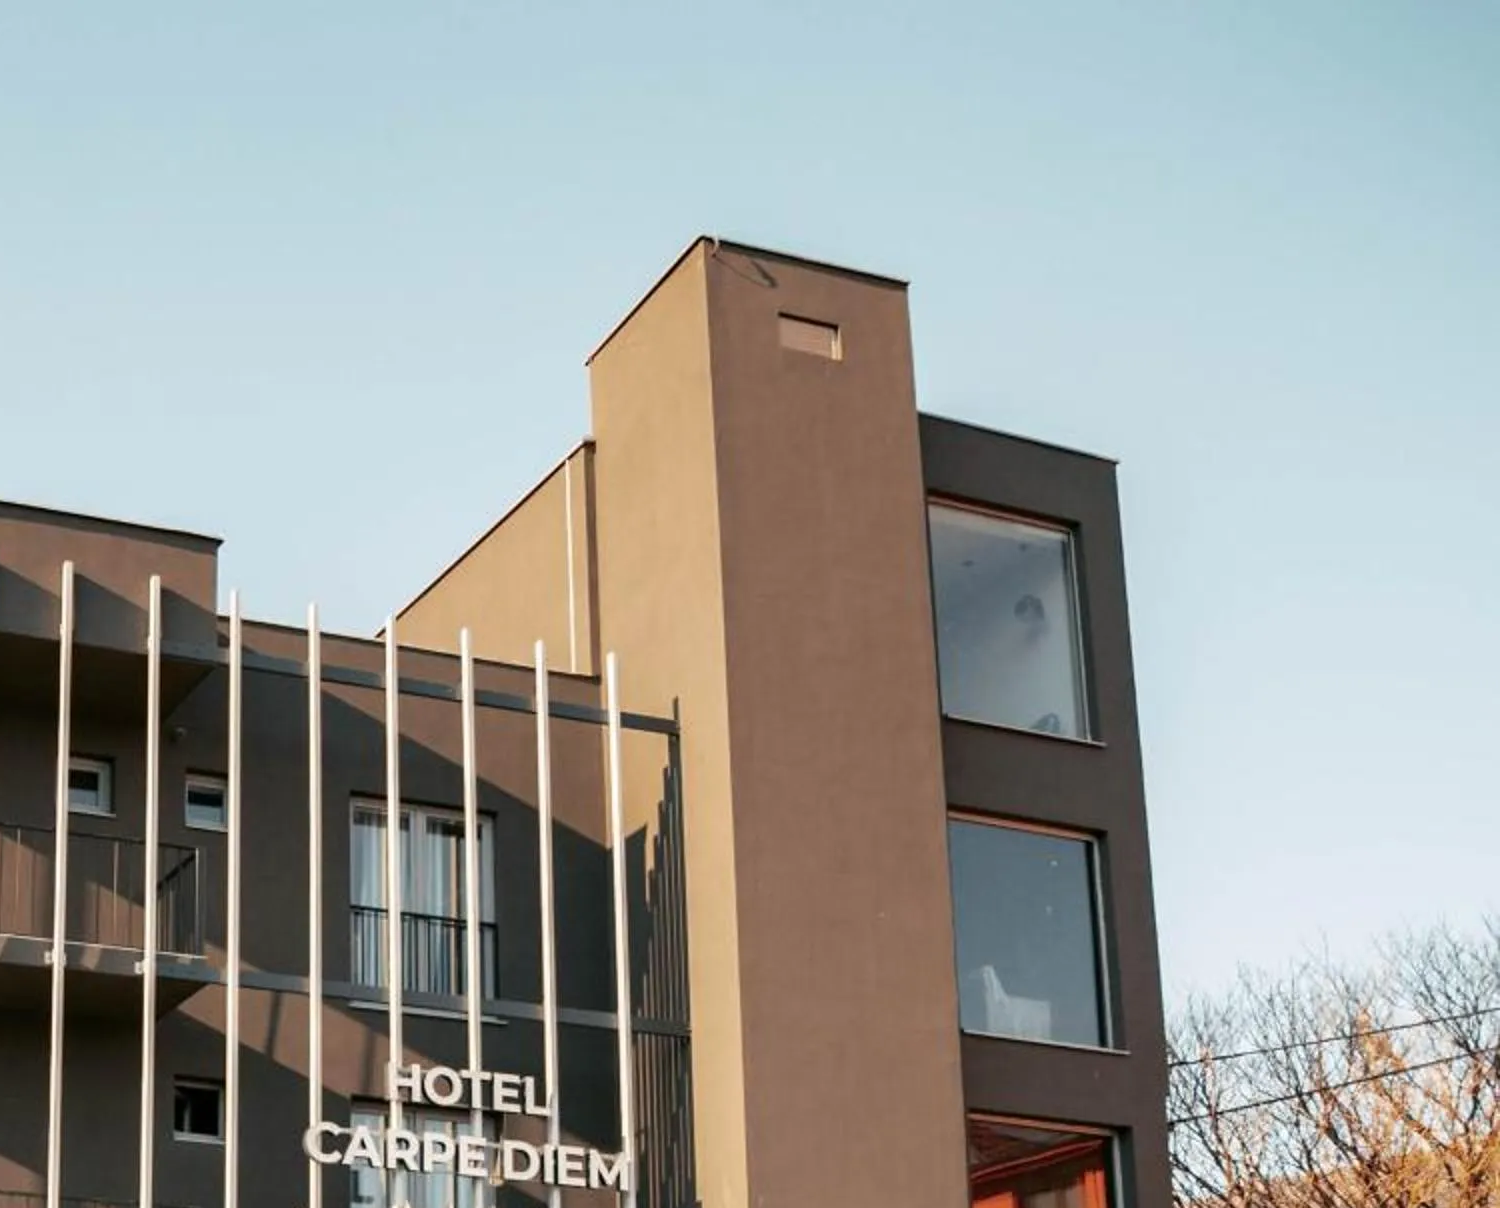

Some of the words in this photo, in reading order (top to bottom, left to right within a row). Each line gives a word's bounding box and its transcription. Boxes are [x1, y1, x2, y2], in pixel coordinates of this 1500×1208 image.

[388, 1062, 552, 1117] HOTEL
[304, 1121, 489, 1178] CARPE
[502, 1138, 632, 1192] DIEM
